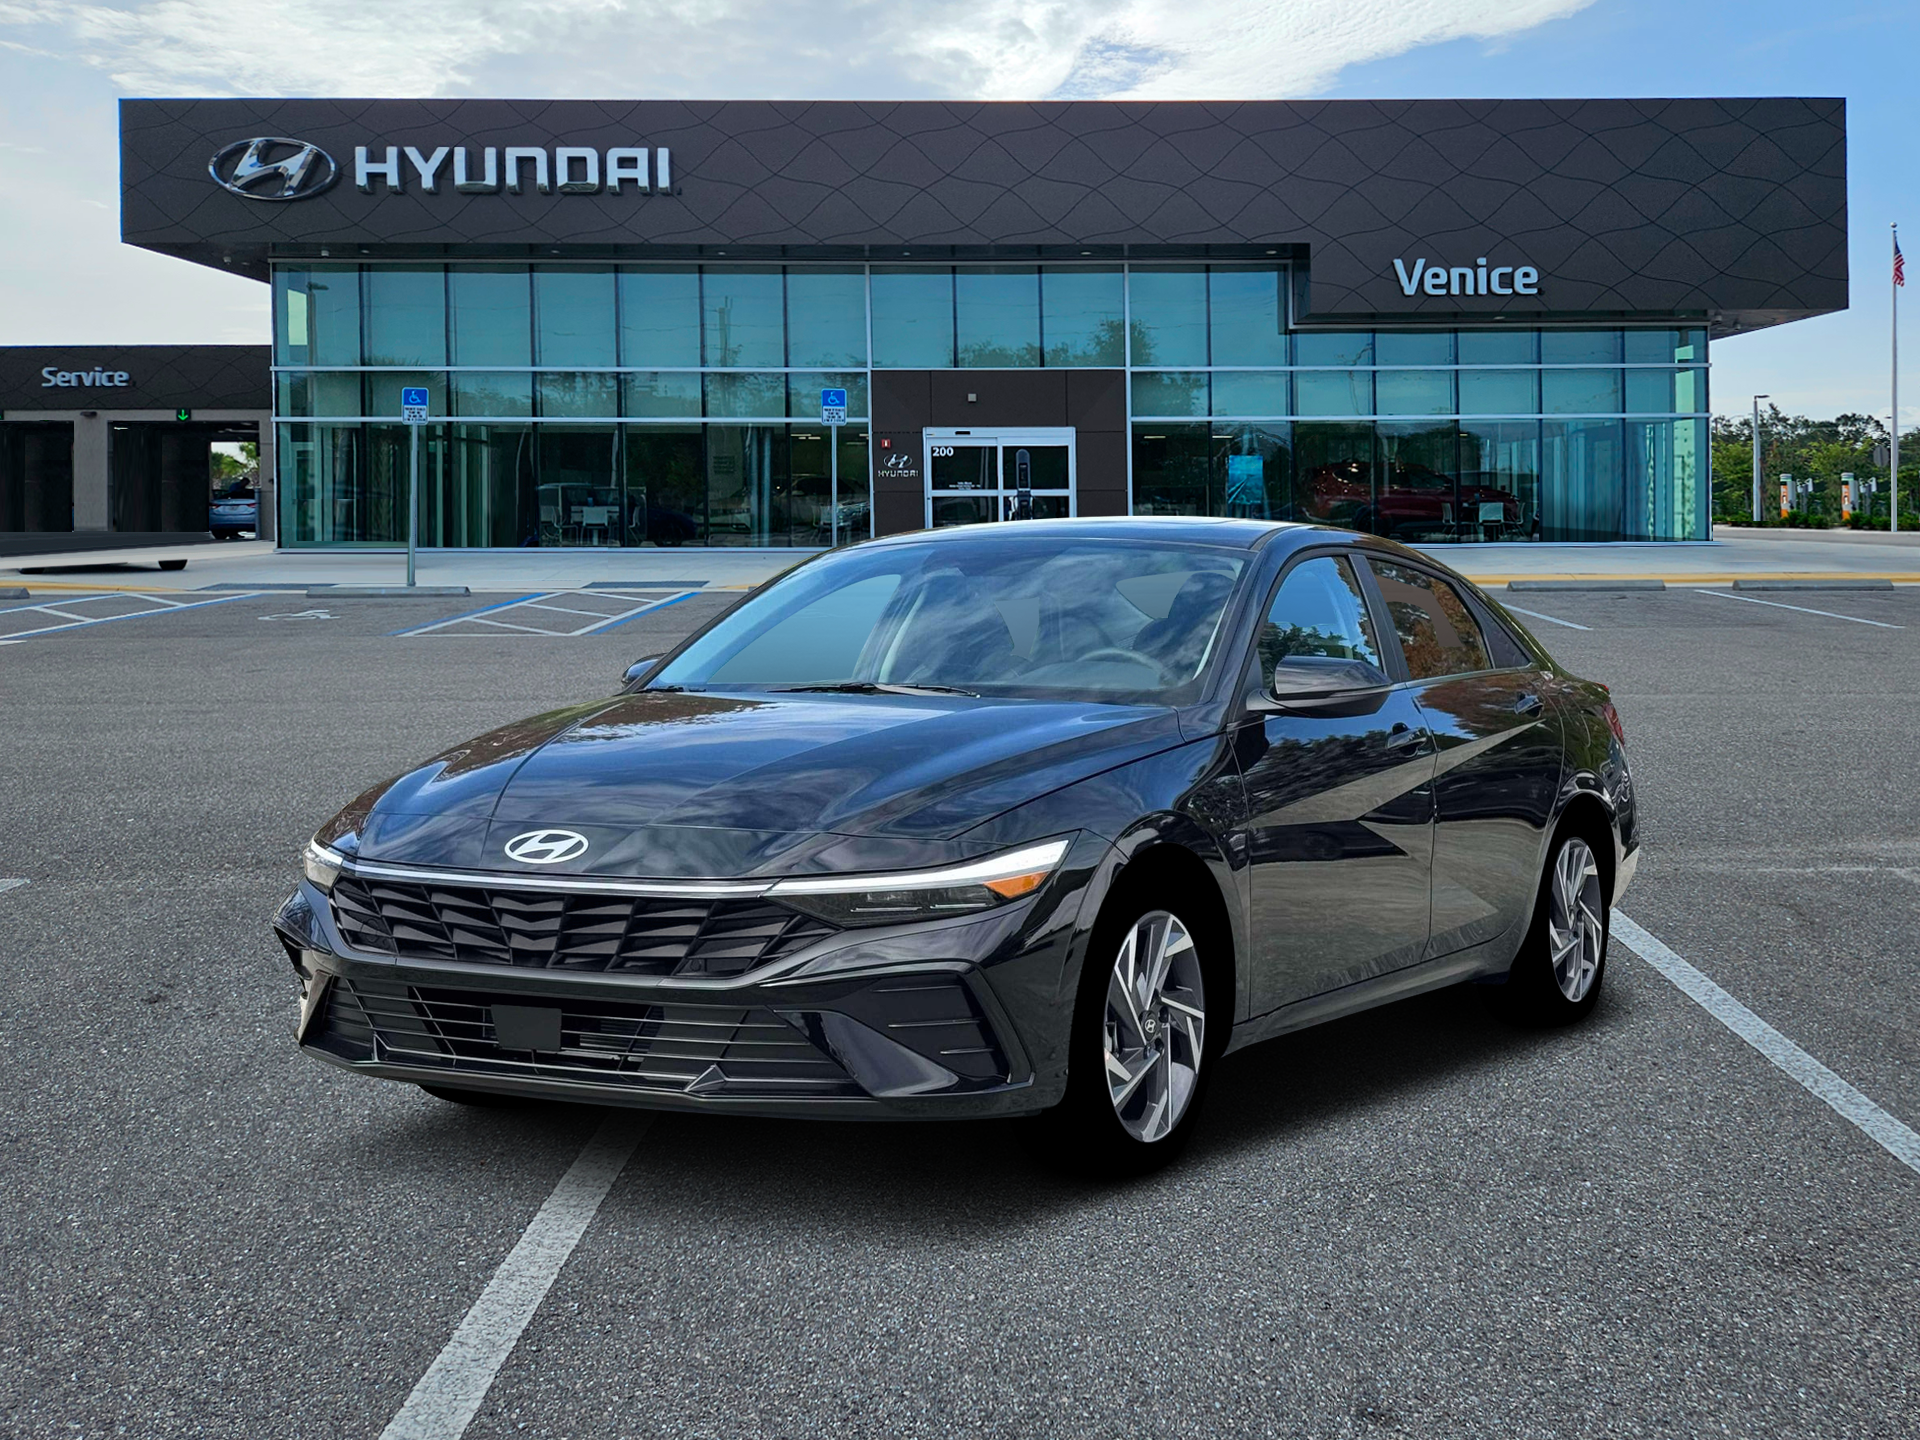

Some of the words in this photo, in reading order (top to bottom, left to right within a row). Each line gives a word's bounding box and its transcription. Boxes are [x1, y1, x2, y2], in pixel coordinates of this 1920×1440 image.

[354, 146, 671, 193] HYUNDAI
[1392, 257, 1539, 296] Venice
[41, 366, 130, 388] Service
[932, 446, 955, 457] 200
[878, 469, 919, 478] HYUNDAI
